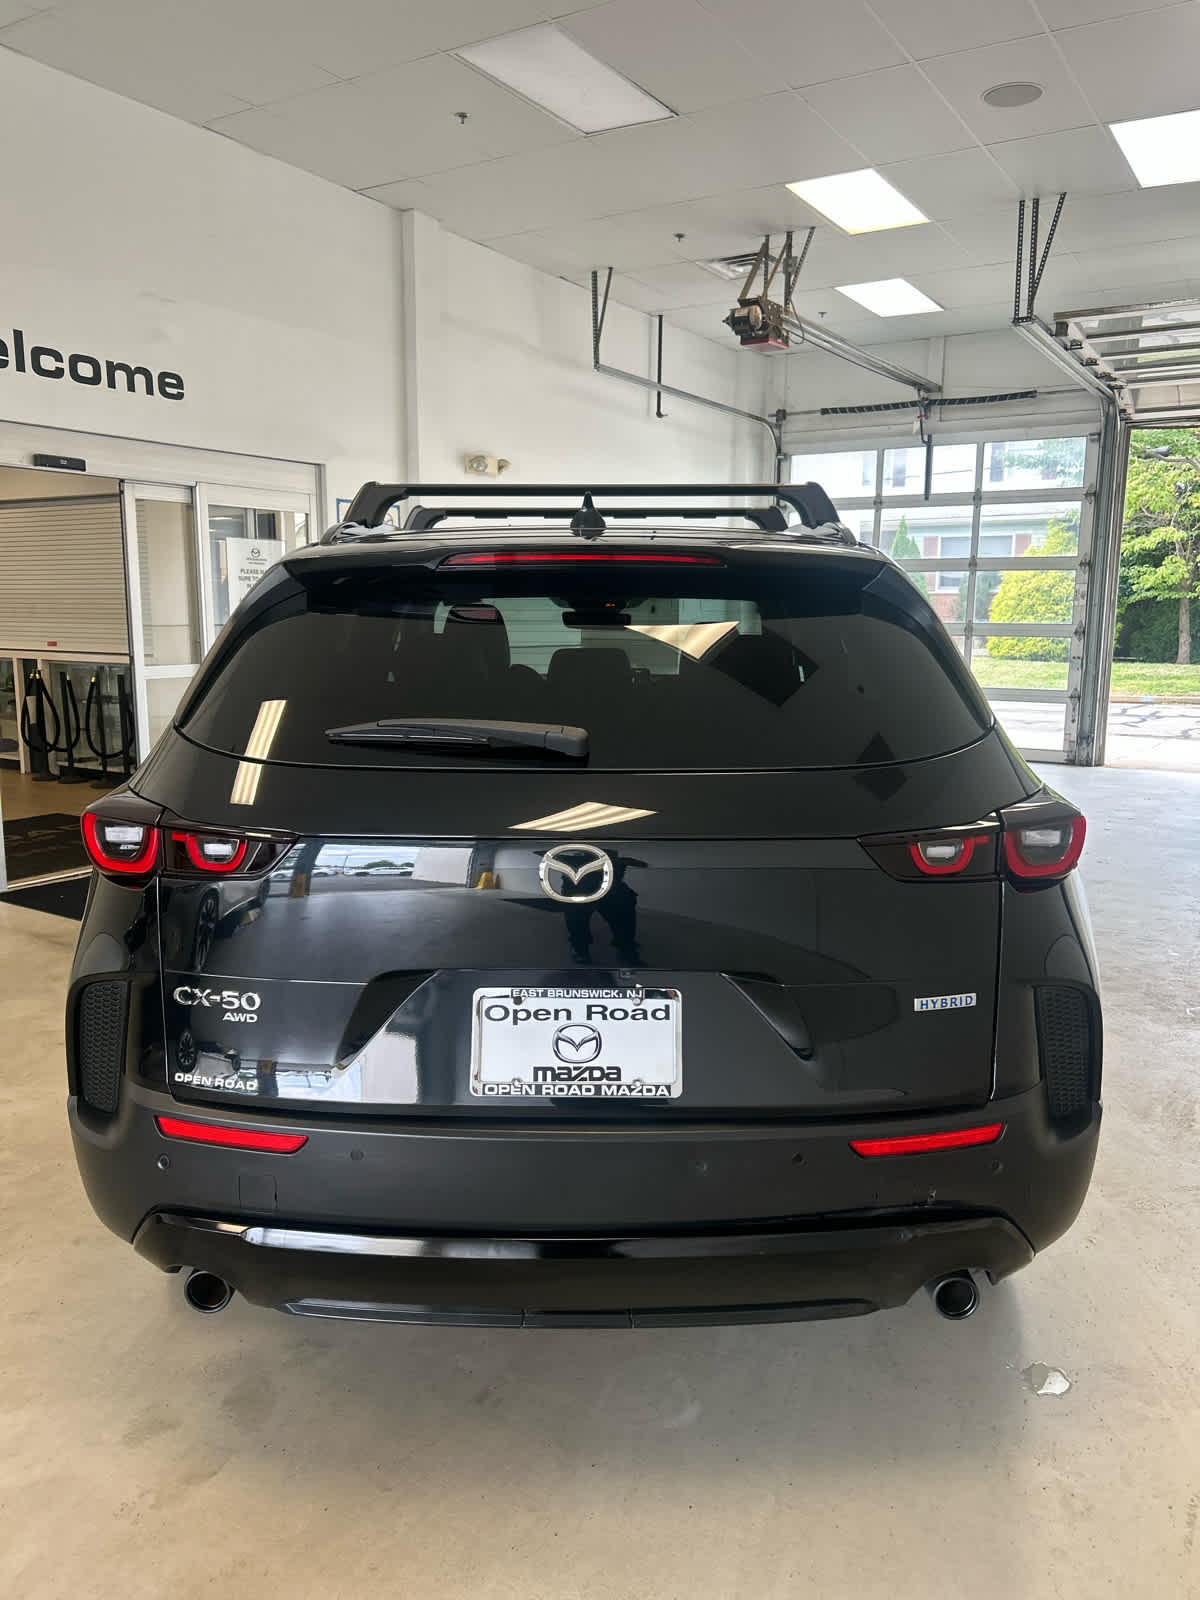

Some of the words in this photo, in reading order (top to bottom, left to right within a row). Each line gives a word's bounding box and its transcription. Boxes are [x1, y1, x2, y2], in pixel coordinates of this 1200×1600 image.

[0, 328, 185, 401] lcome
[173, 985, 261, 1011] CX-50
[512, 989, 544, 998] EAST
[548, 989, 623, 999] BRUNSWICK,
[627, 990, 642, 999] NJ
[920, 995, 974, 1010] HYBRID
[222, 1012, 258, 1023] AWD
[484, 1004, 572, 1025] Open
[586, 1004, 670, 1021] Road
[174, 1072, 212, 1086] OPEN
[214, 1077, 258, 1091] ROAD
[533, 1066, 622, 1082] mazda
[484, 1084, 536, 1096] OPEN
[542, 1084, 595, 1096] ROAD
[601, 1085, 670, 1097] MAZDA
